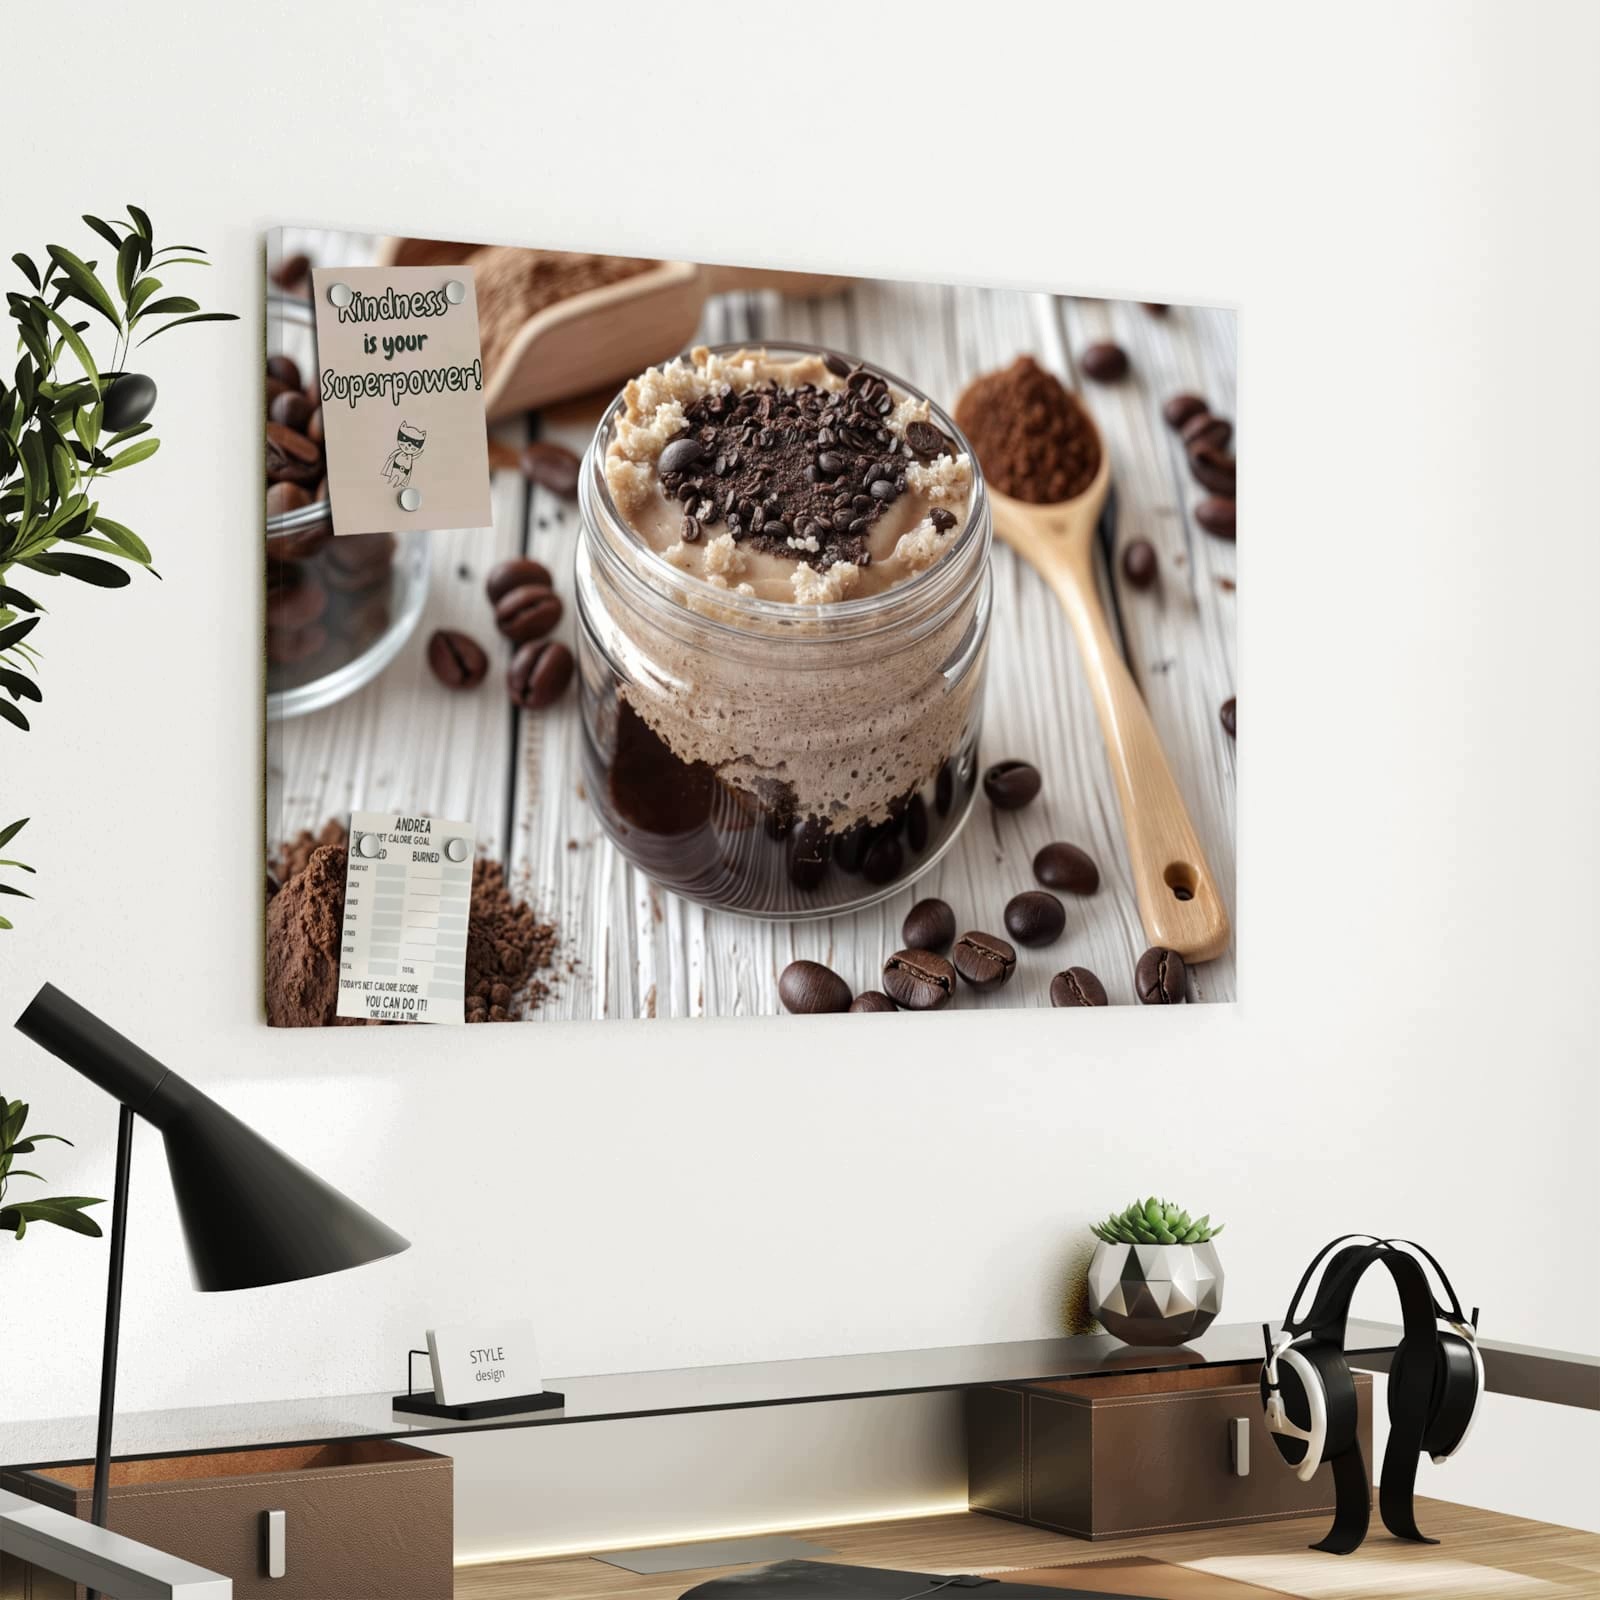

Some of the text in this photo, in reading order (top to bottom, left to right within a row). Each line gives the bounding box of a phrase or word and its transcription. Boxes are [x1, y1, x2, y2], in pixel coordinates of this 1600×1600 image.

[338, 286, 448, 324] Kindness
[364, 333, 428, 360] is your
[322, 358, 482, 409] Superpower!
[395, 816, 431, 834] ANDREA
[388, 833, 412, 845] CALORIE
[413, 836, 430, 846] GOAL
[412, 850, 440, 863] BURNED
[402, 966, 415, 974] TOTAL
[363, 980, 373, 991] NET
[374, 982, 398, 992] CALORIE
[399, 983, 419, 994] SCORE
[366, 994, 428, 1012] YOU CAN DO IT!
[370, 1009, 380, 1018] ONE
[381, 1010, 391, 1019] DAY
[392, 1011, 400, 1019] AT
[406, 1012, 418, 1021] TIME
[470, 1347, 505, 1364] STYLE
[475, 1368, 505, 1383] design
